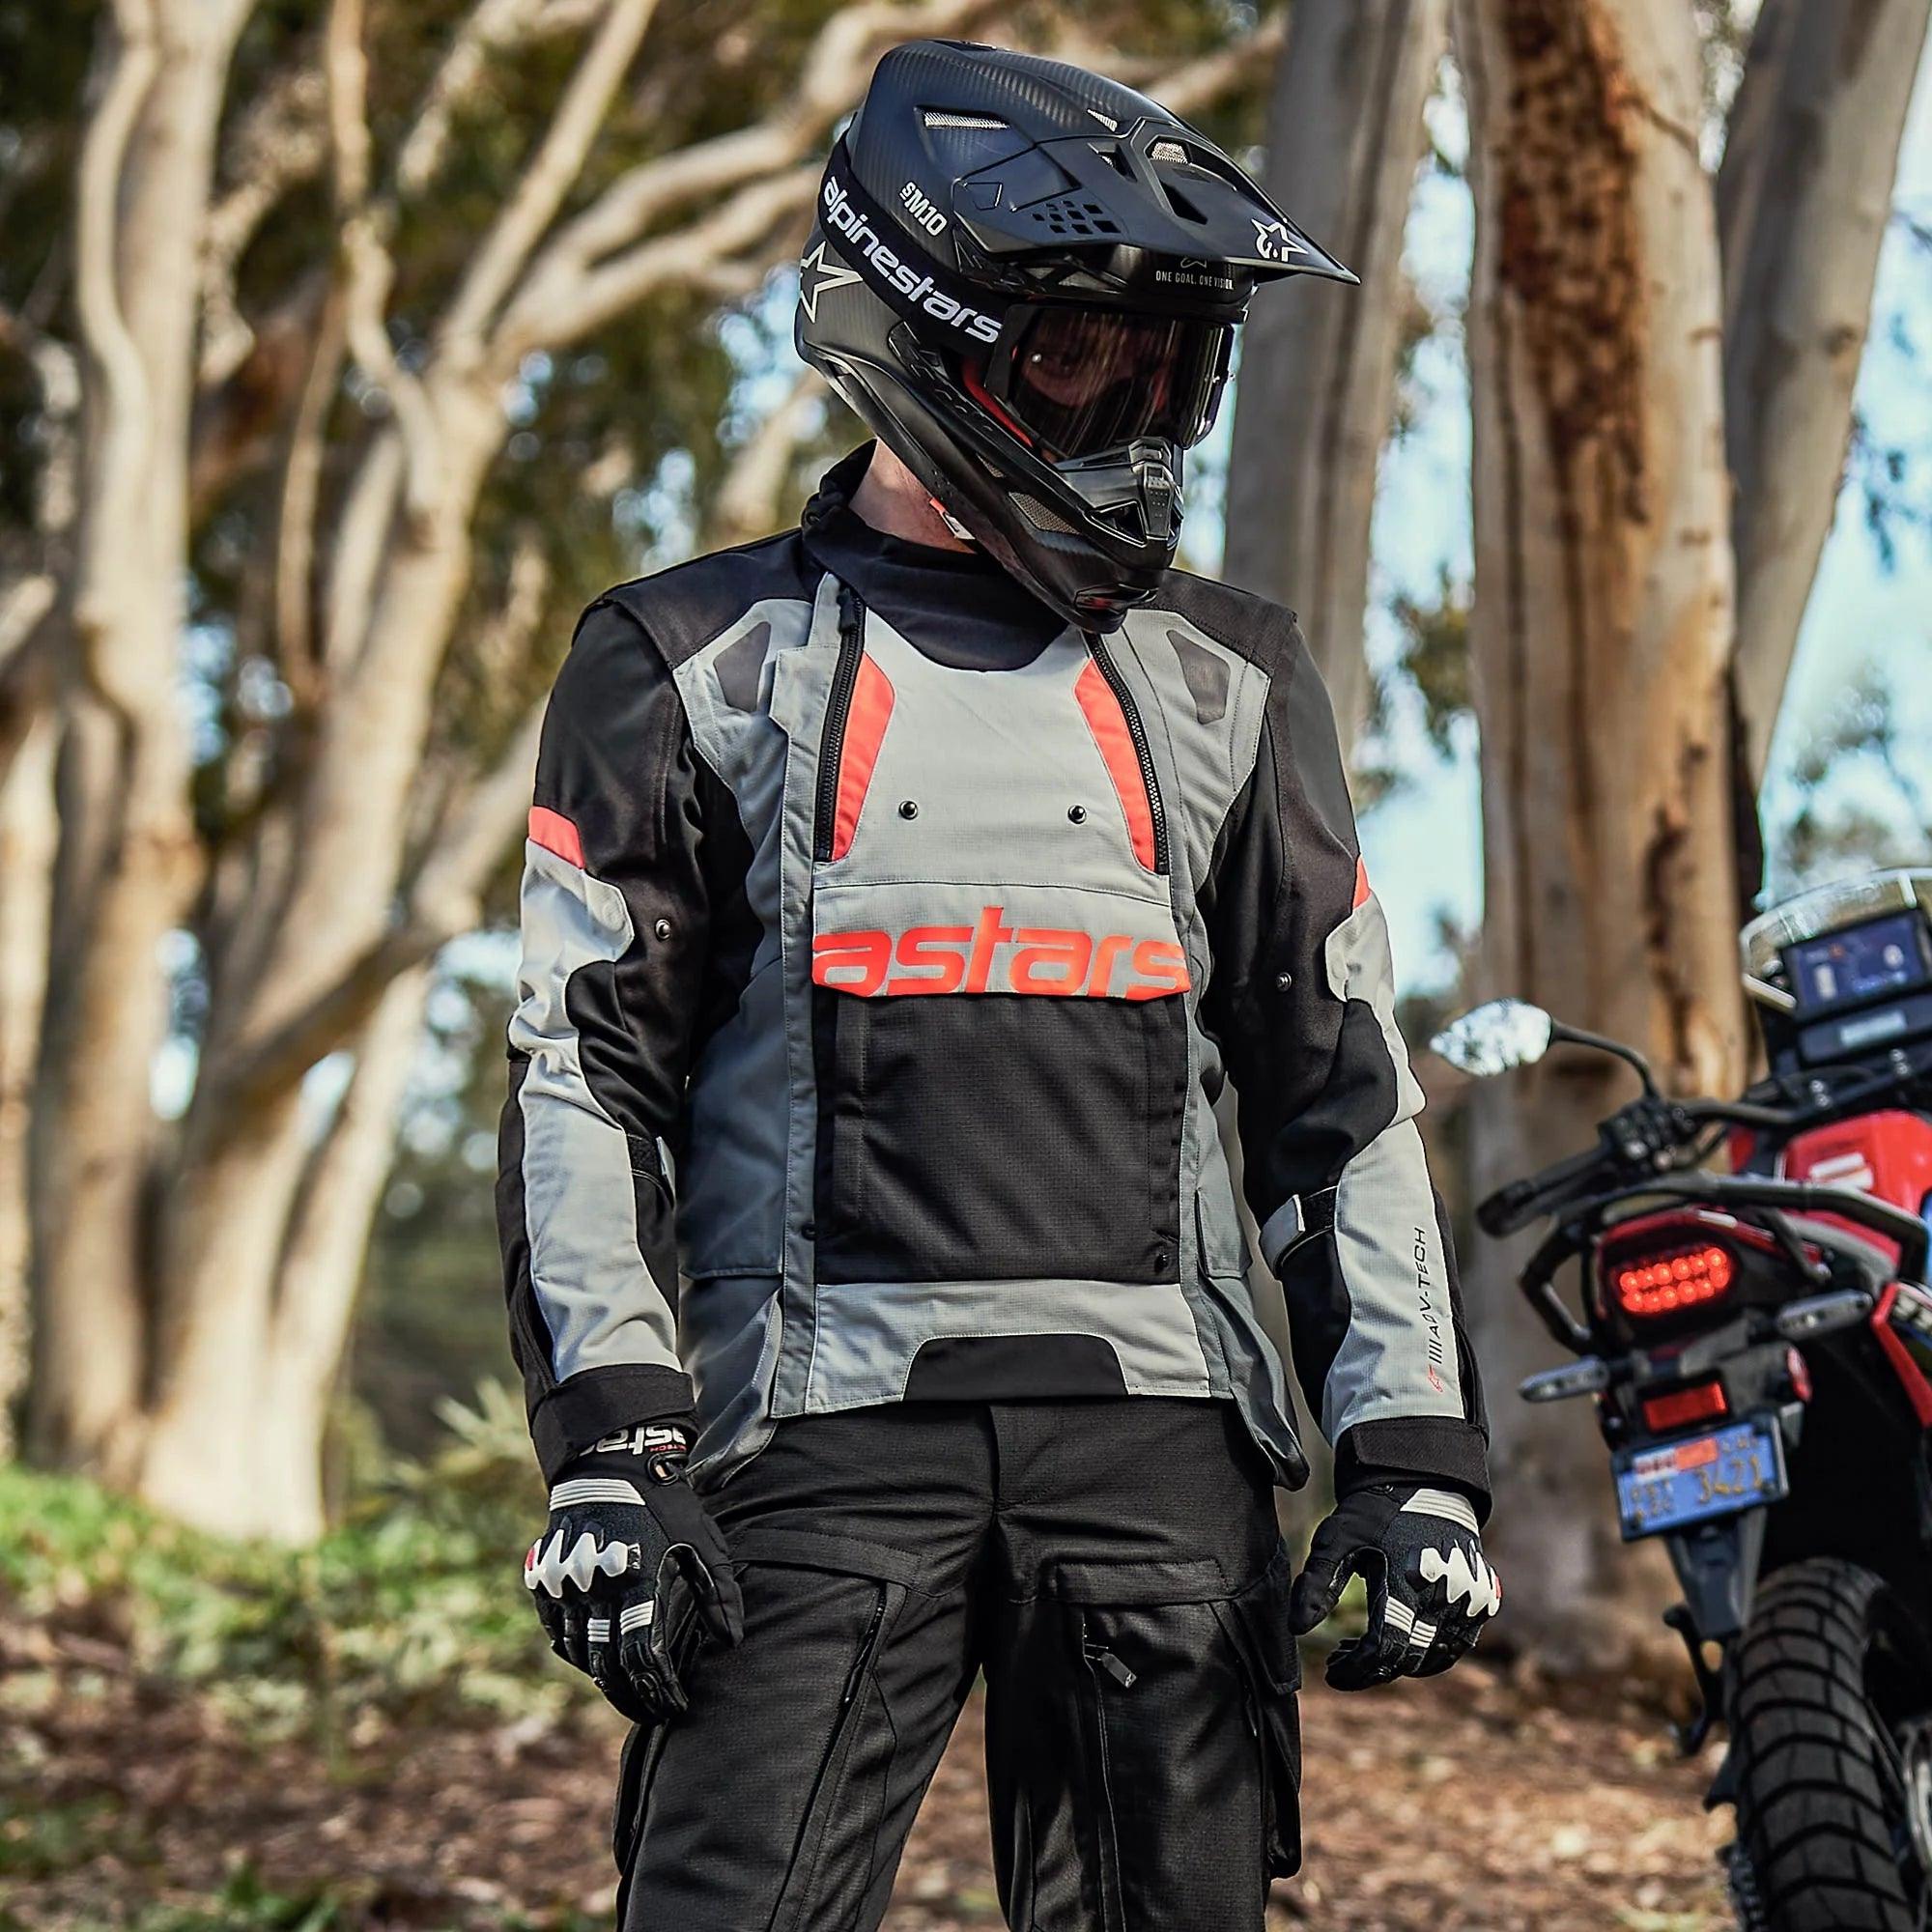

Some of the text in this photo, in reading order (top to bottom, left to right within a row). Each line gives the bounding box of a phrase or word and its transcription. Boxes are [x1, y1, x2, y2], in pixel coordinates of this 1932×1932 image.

[823, 176, 1004, 344] alpinestars
[1155, 270, 1173, 282] ONE
[1199, 275, 1212, 287] ONE
[812, 905, 1189, 1001] astars
